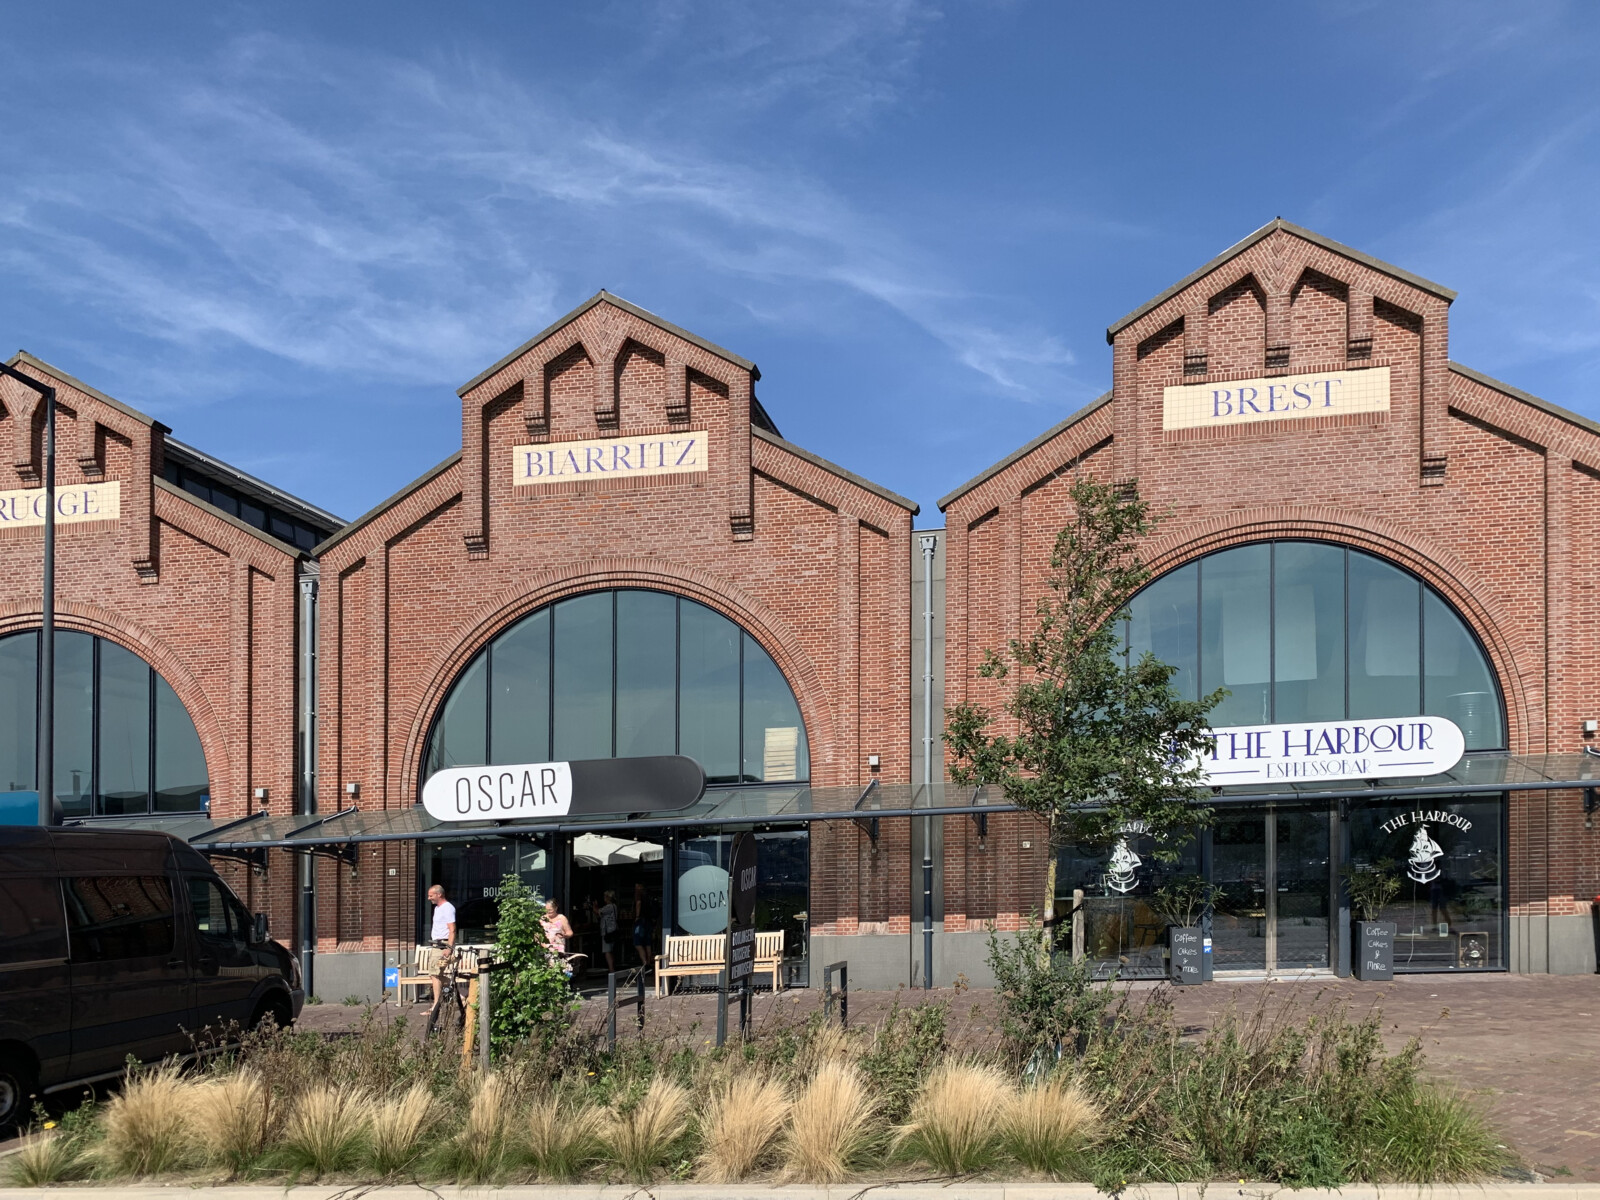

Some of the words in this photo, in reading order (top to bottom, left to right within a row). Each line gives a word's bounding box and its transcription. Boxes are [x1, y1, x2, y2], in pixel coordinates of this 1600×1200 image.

[1210, 379, 1342, 417] BREST
[524, 439, 697, 478] BIARRITZ
[1201, 731, 1272, 760] THE
[1282, 723, 1435, 757] HARBOUR
[1266, 759, 1372, 779] ESPRESSOBAR
[455, 768, 558, 814] OSCAR
[1379, 813, 1410, 834] THE
[1411, 810, 1473, 833] HARBOUR
[740, 865, 757, 892] OSCAR
[689, 890, 729, 912] OSCA
[1174, 933, 1198, 944] Coffee
[1366, 926, 1389, 936] Coffee
